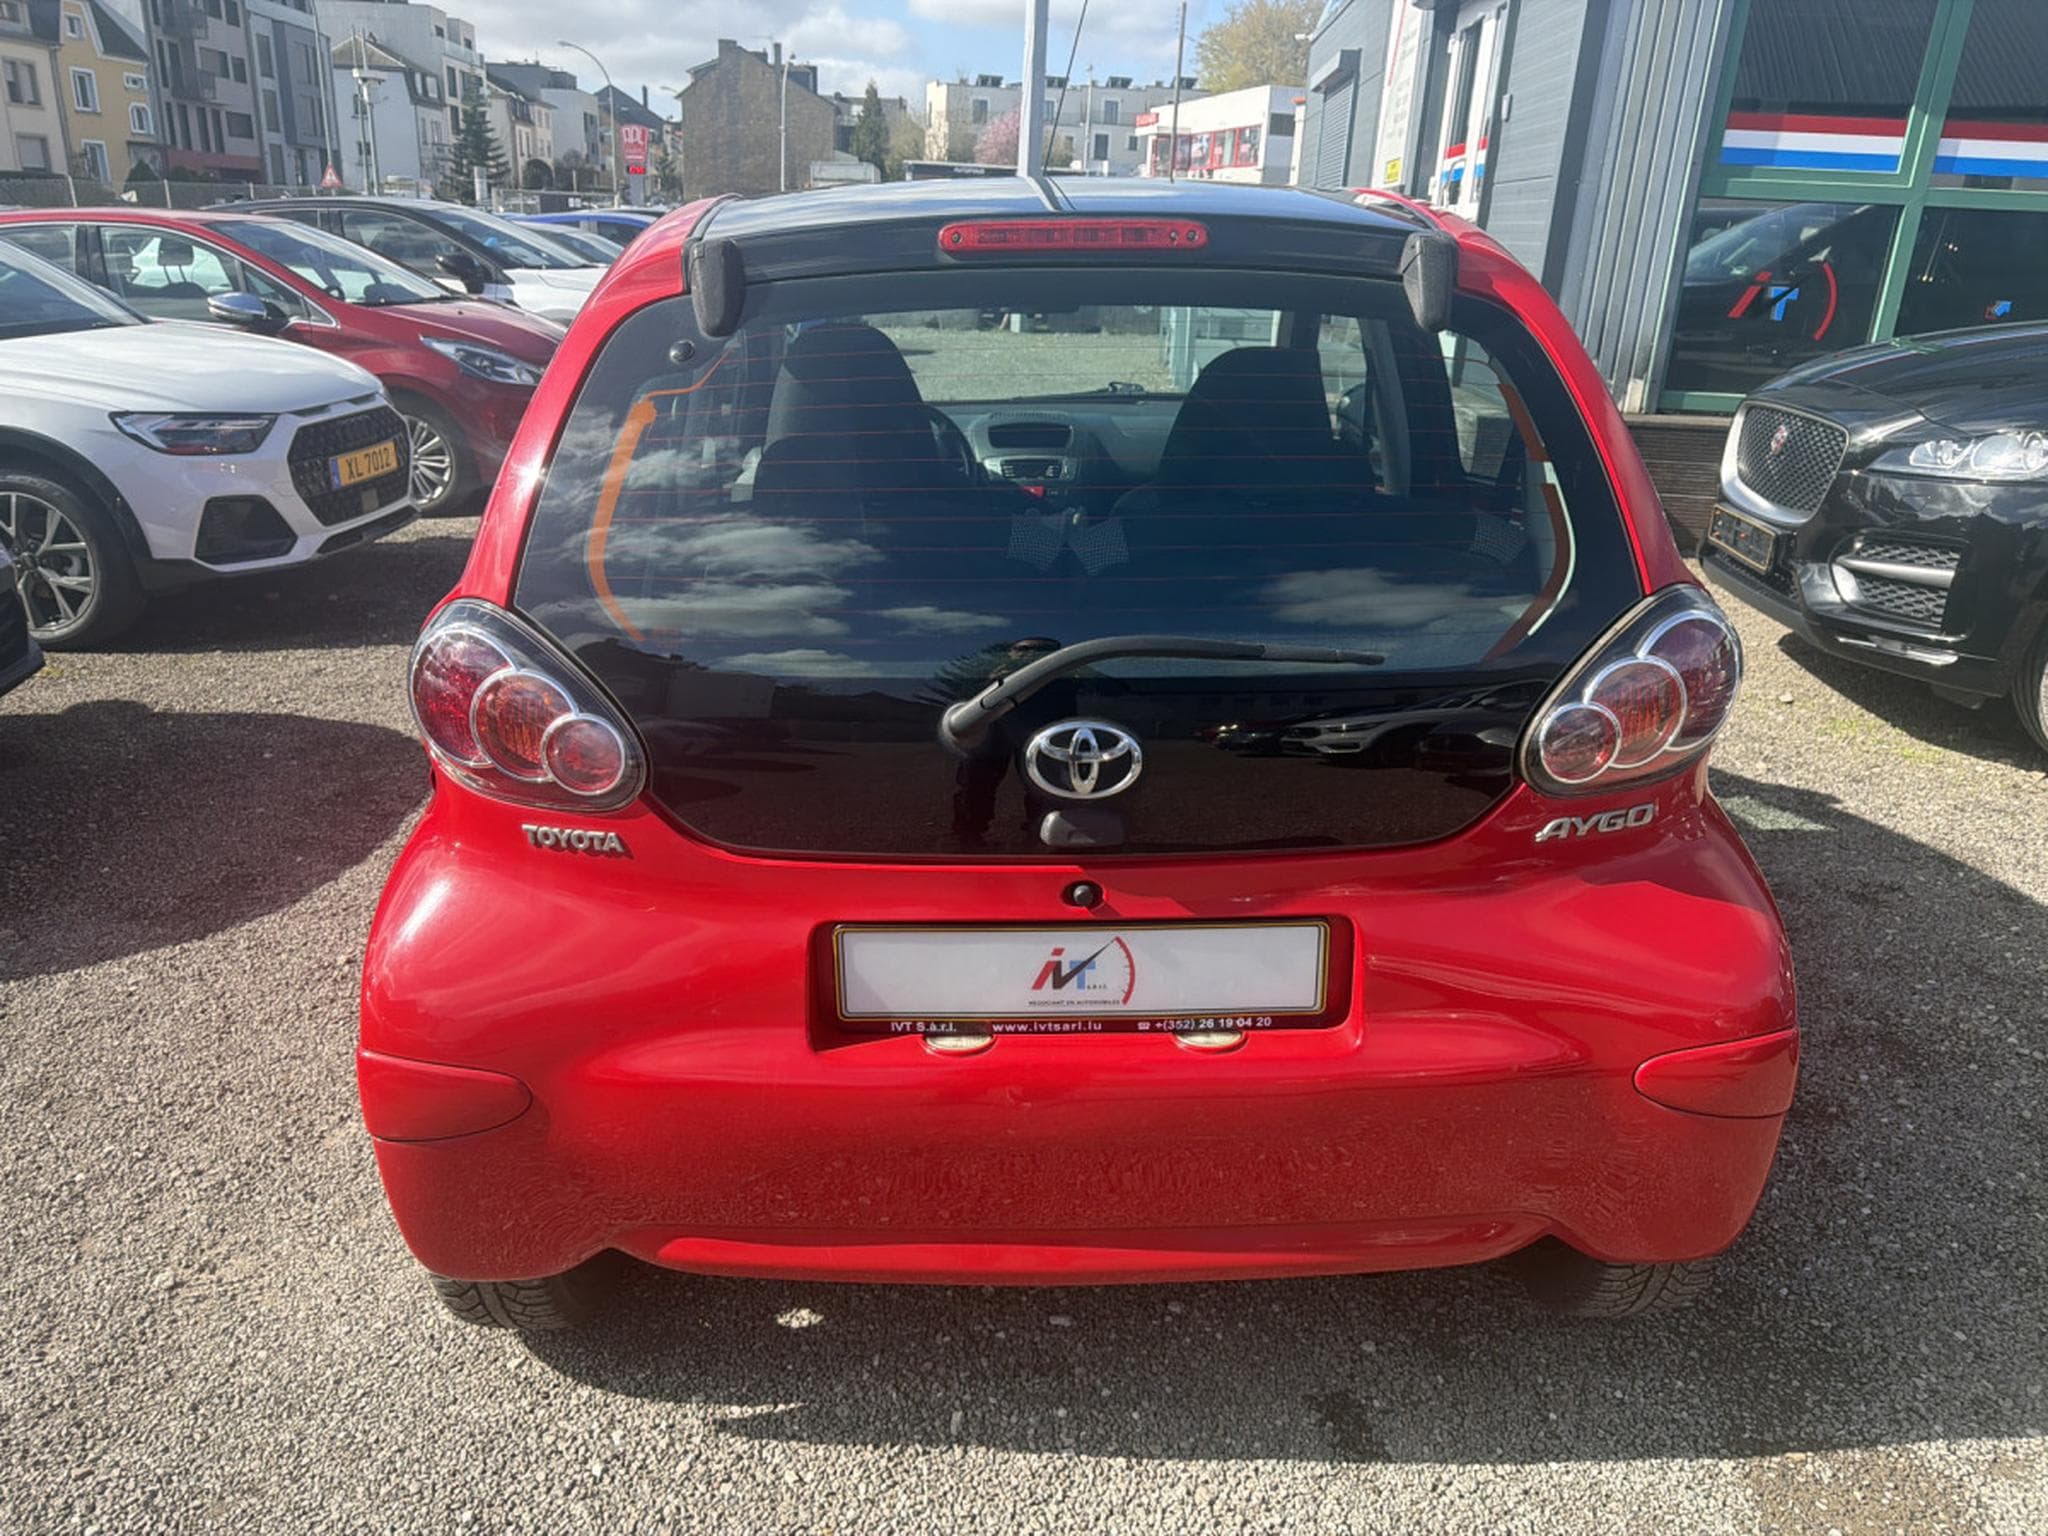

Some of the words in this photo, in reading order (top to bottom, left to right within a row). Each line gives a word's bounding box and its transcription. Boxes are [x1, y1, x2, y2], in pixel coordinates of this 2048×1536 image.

[345, 457, 364, 480] XL
[364, 447, 392, 474] 7012
[521, 823, 625, 853] TOYOTA
[1534, 803, 1655, 843] AYGO
[890, 1021, 912, 1032] IVT
[992, 1021, 1103, 1032] www.ivtsarl.lu
[1155, 1019, 1196, 1031] +(352)
[1199, 1018, 1215, 1029] 26
[1219, 1018, 1233, 1028] 19
[1235, 1018, 1252, 1028] 04
[1255, 1016, 1272, 1027] 20
